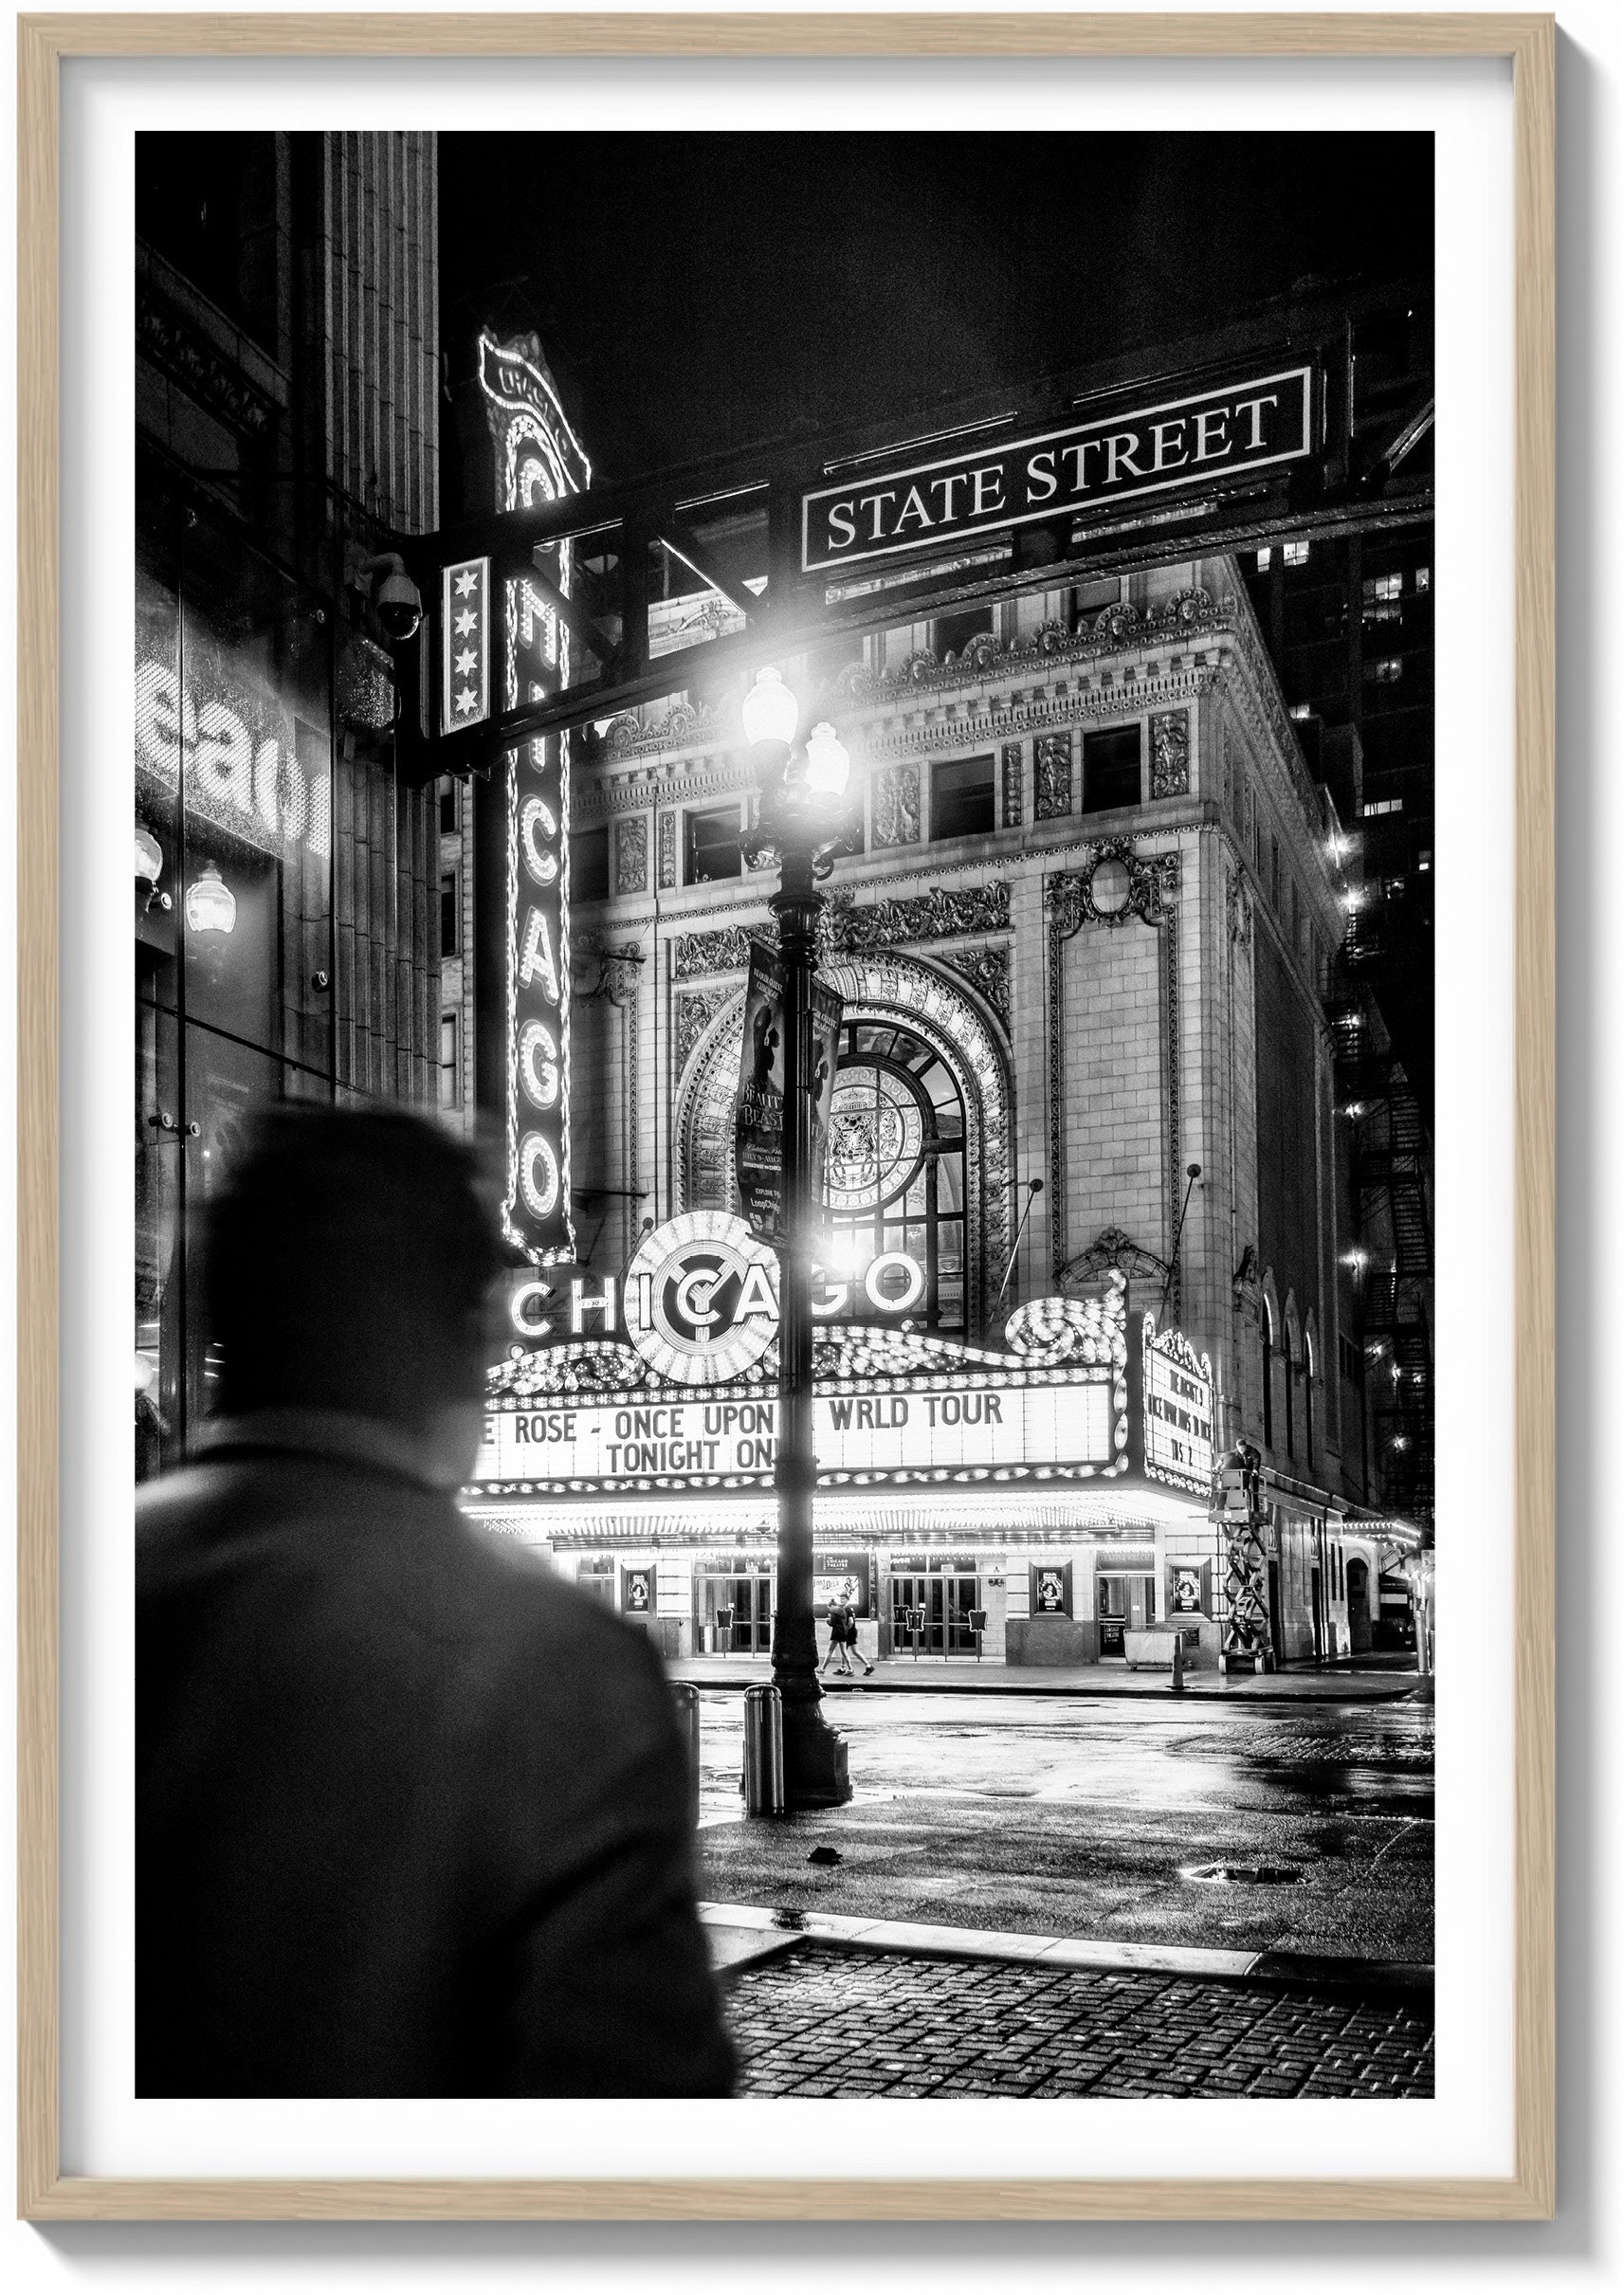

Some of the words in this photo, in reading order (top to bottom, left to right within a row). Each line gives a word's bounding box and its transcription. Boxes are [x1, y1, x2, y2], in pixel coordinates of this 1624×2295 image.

[828, 464, 1006, 551] STATE
[1027, 394, 1278, 503] STREET
[511, 1251, 922, 1338] CHICAGO
[515, 1412, 577, 1444] ROSE
[615, 1410, 684, 1440] ONCE
[704, 1404, 774, 1435] UPON
[829, 1396, 909, 1430] WRLD
[922, 1393, 1003, 1427] TOUR
[606, 1440, 721, 1472] TONIGHT
[737, 1438, 779, 1468] ON
